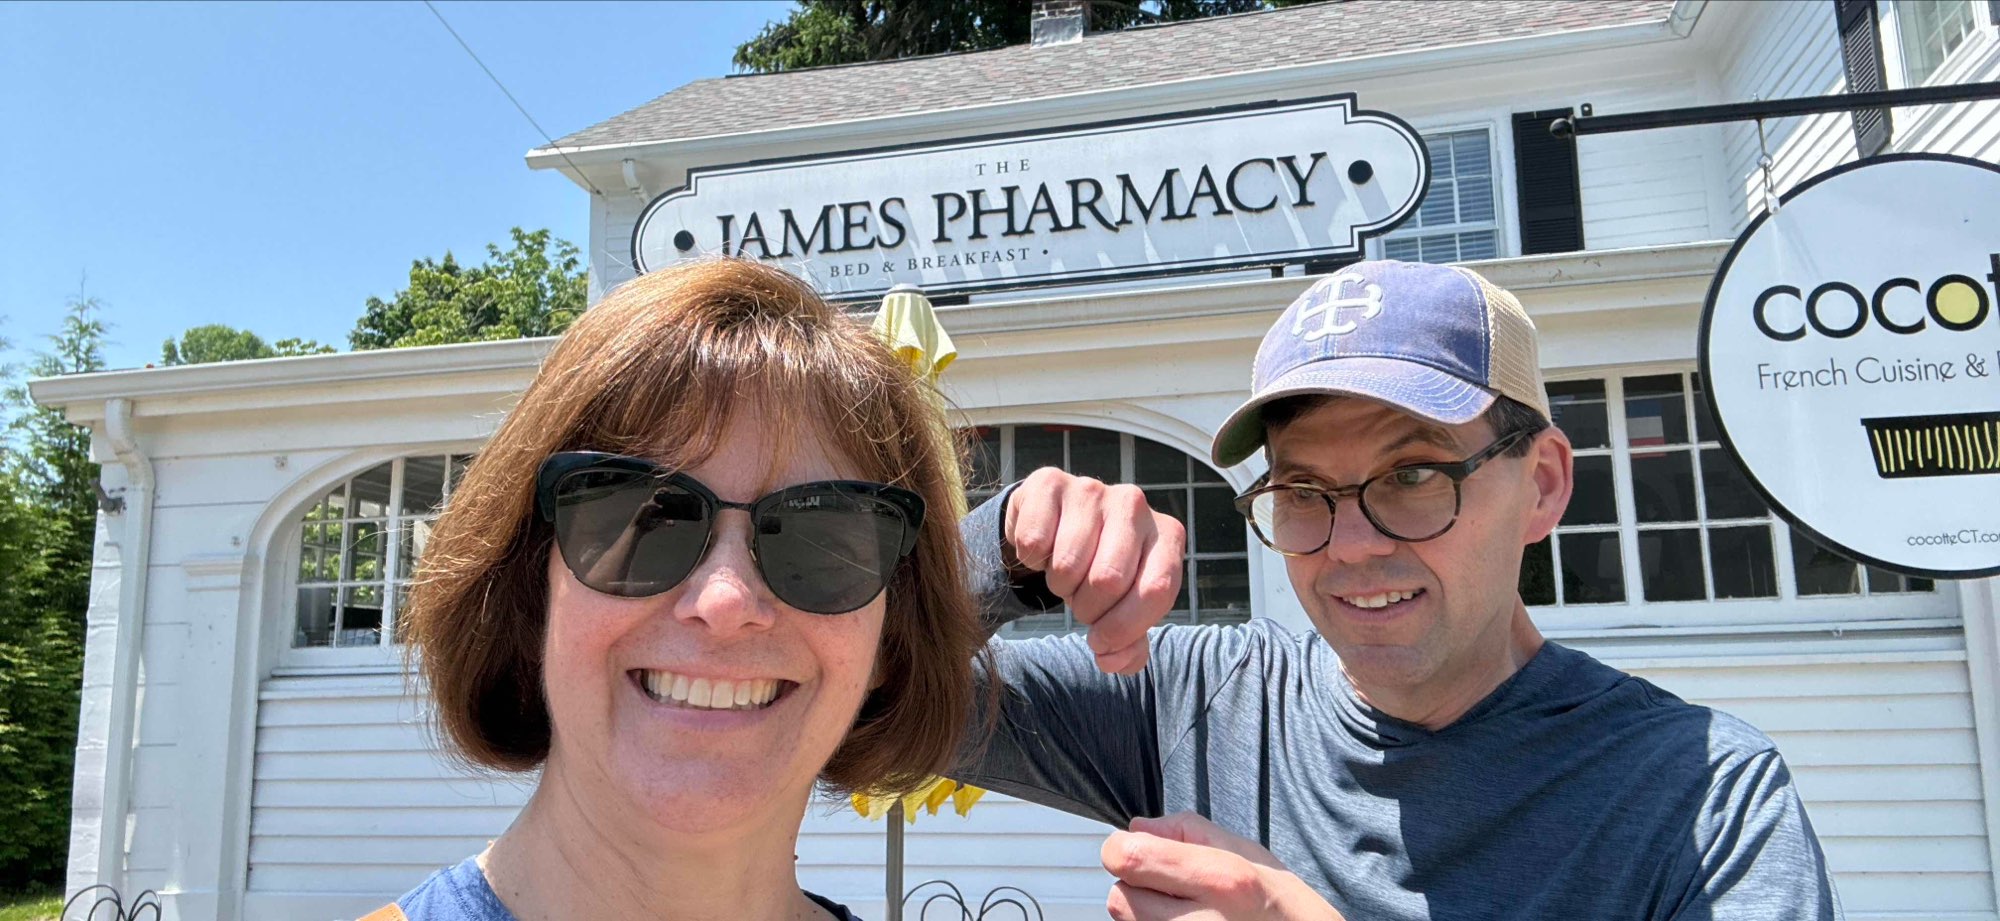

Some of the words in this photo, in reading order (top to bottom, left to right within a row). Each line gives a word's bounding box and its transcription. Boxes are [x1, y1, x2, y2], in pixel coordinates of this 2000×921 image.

[975, 158, 1031, 176] THE
[716, 197, 907, 258] JAMES
[931, 151, 1328, 243] PHARMACY
[830, 263, 870, 278] BED
[882, 261, 895, 273] &
[908, 247, 1031, 271] BREAKFAST
[1757, 357, 1848, 390] French
[1855, 354, 1957, 384] Cuisine
[1965, 353, 1989, 378] &
[1907, 529, 2000, 546] cocotteCT.co
